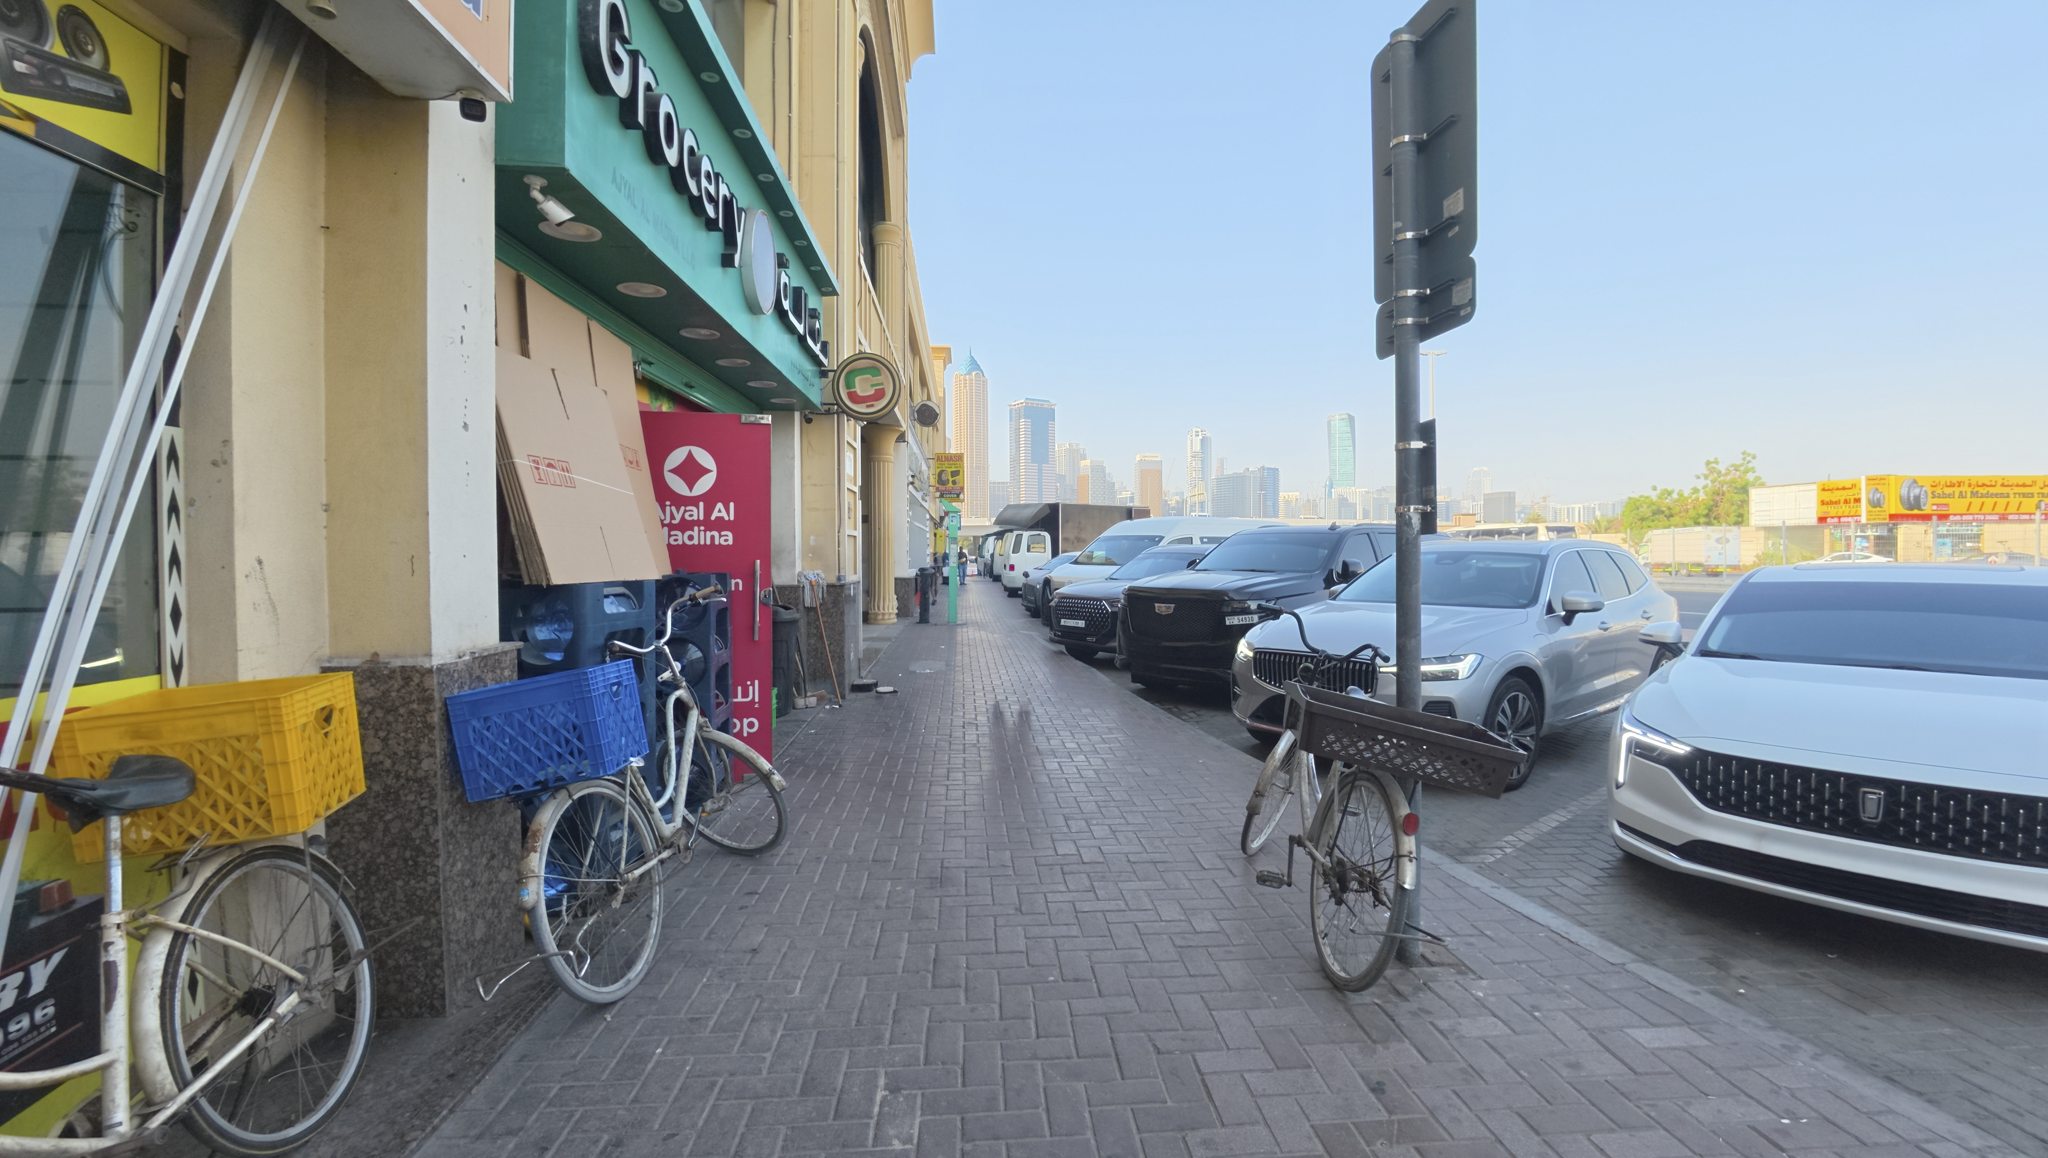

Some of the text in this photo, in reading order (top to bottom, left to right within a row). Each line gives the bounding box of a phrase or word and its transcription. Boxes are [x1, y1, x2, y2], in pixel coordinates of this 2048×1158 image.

[580, 0, 746, 268] Grocery
[611, 166, 637, 210] AJYAL
[640, 198, 650, 224] AL
[710, 501, 735, 521] Al
[1931, 491, 1955, 499] Sahel
[1957, 491, 1967, 499] Al
[1970, 490, 2010, 499] Madeena
[0, 997, 56, 1047] 96
